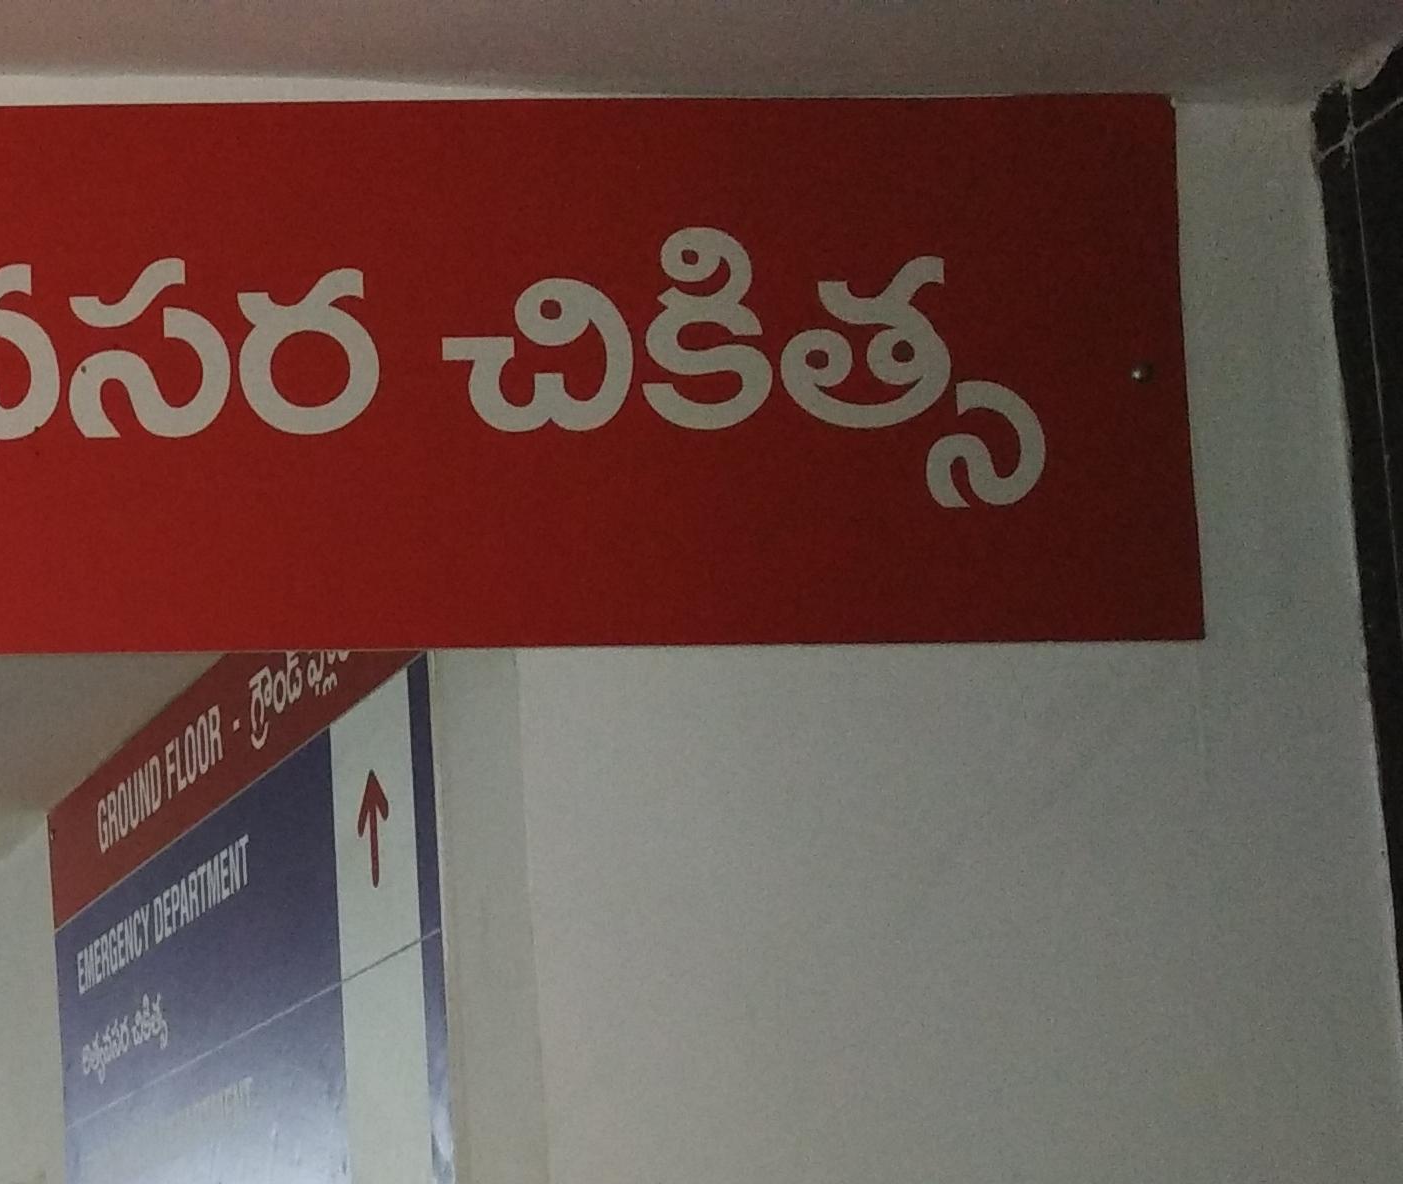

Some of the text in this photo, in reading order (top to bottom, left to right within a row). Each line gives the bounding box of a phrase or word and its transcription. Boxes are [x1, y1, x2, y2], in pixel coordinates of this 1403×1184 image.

[442, 227, 1045, 507] చికిత్స
[97, 755, 162, 854] GROUND
[165, 705, 223, 800] FLOOR
[77, 834, 249, 996] EMERGENCY DEPARTMENT
